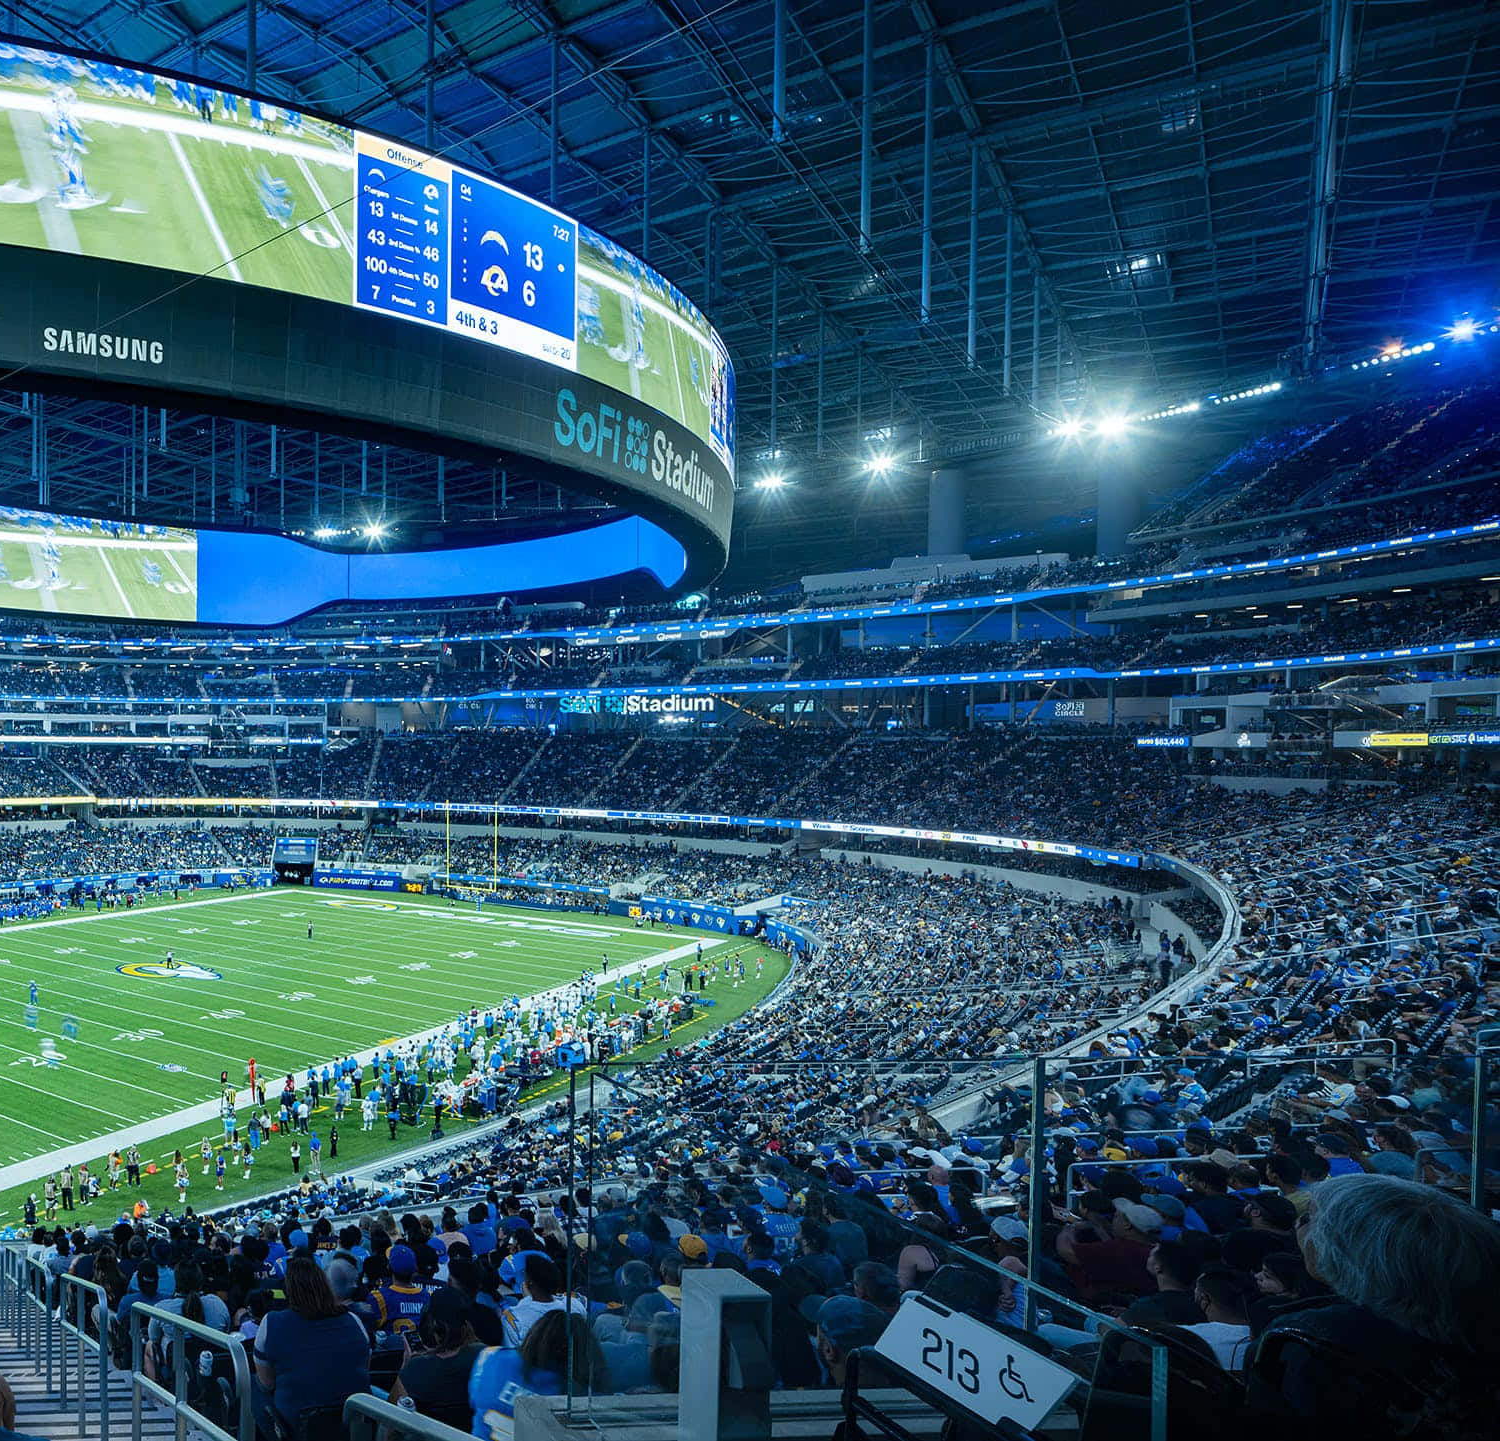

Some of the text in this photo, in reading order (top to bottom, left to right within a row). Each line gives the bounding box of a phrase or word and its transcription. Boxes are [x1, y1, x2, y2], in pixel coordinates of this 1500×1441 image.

[387, 148, 423, 169] Offense
[369, 201, 384, 217] 13
[424, 219, 438, 235] 14
[367, 229, 385, 245] 43
[423, 246, 439, 262] 46
[523, 241, 543, 272] 13
[365, 256, 387, 274] 100
[423, 272, 439, 289] 50
[371, 285, 380, 300] 7
[426, 300, 435, 315] 3
[522, 280, 536, 307] 6
[455, 310, 498, 336] 4th & 3
[43, 327, 164, 365] SAMSUNG
[554, 388, 714, 513] SoFi Stadium
[627, 695, 714, 712] Stadium
[921, 1327, 980, 1394] 213
